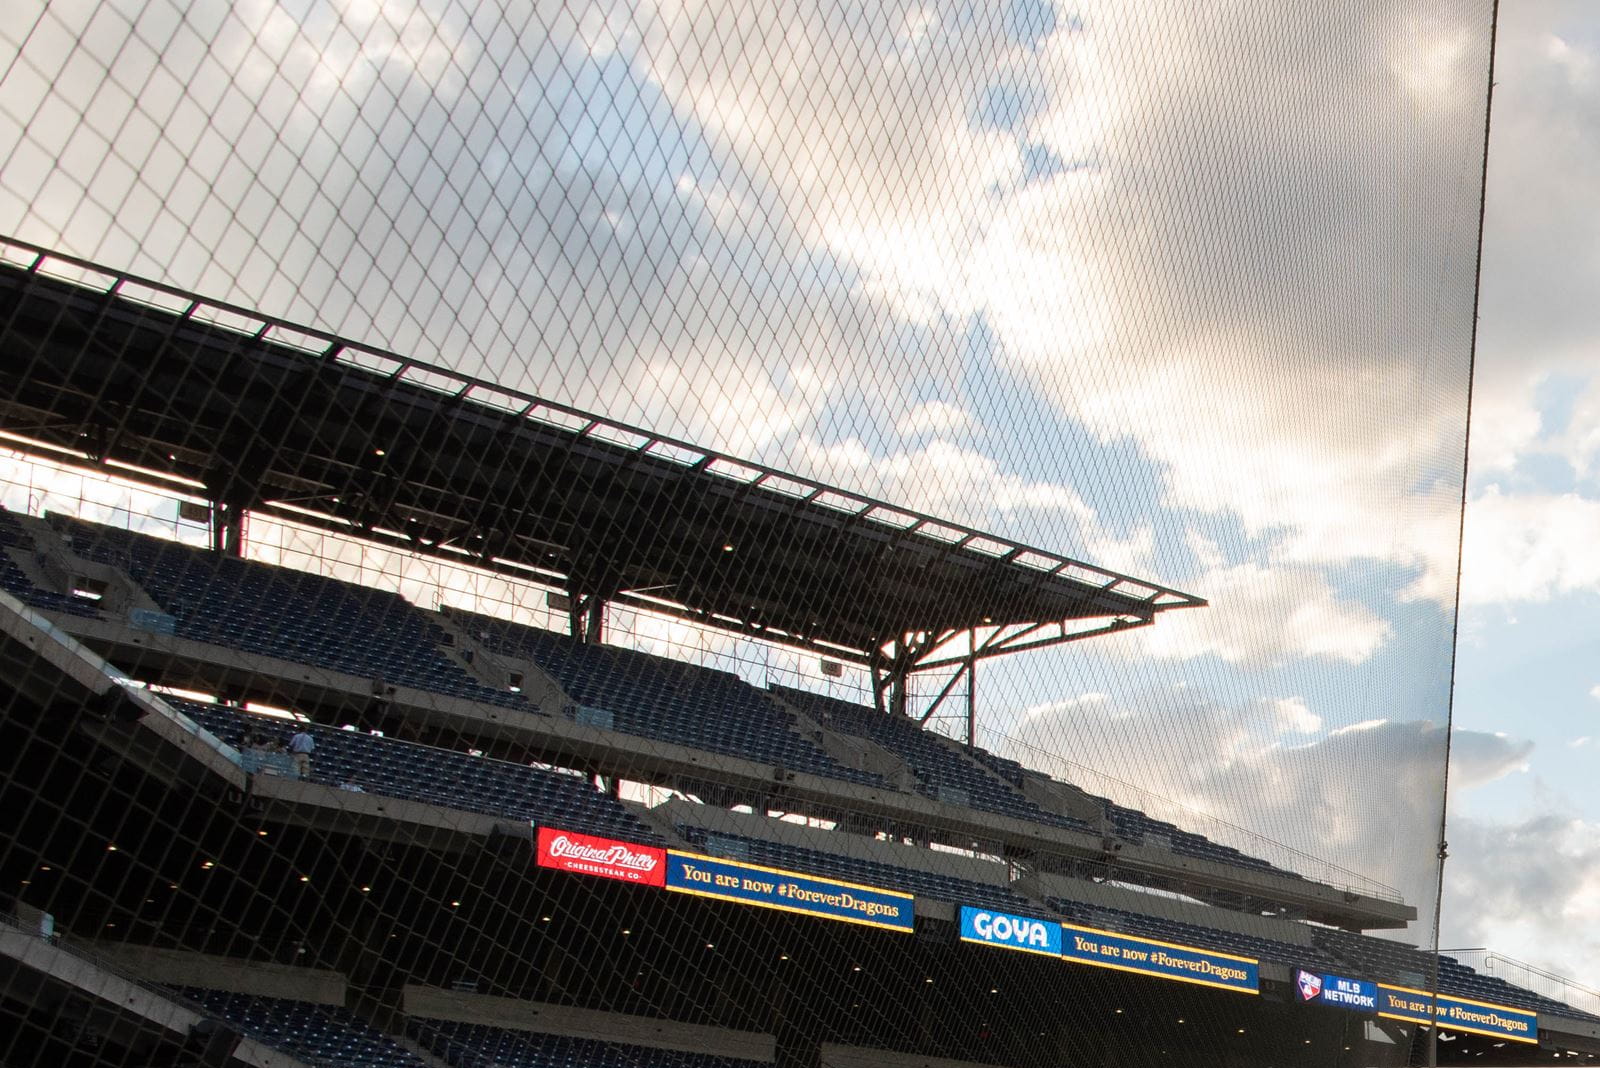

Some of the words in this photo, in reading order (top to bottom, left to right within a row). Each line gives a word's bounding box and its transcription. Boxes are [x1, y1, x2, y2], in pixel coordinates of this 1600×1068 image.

[550, 836, 612, 863] Original
[609, 846, 657, 871] Philly
[567, 861, 625, 877] CHEESESTEAK
[682, 863, 711, 884] You
[715, 873, 740, 888] are
[743, 880, 774, 894] now
[777, 883, 900, 918] #ForeverDragons
[974, 912, 1048, 948] GOYA
[1074, 936, 1098, 953] You
[1101, 943, 1120, 957] are
[1123, 949, 1148, 962] now
[1151, 952, 1248, 981] #ForeverDragons
[1324, 989, 1374, 1007] NETWORK
[1338, 980, 1360, 993] MLB
[1388, 994, 1407, 1009] You
[1409, 1001, 1425, 1013] are
[1450, 1007, 1528, 1032] #ForeverDragons
